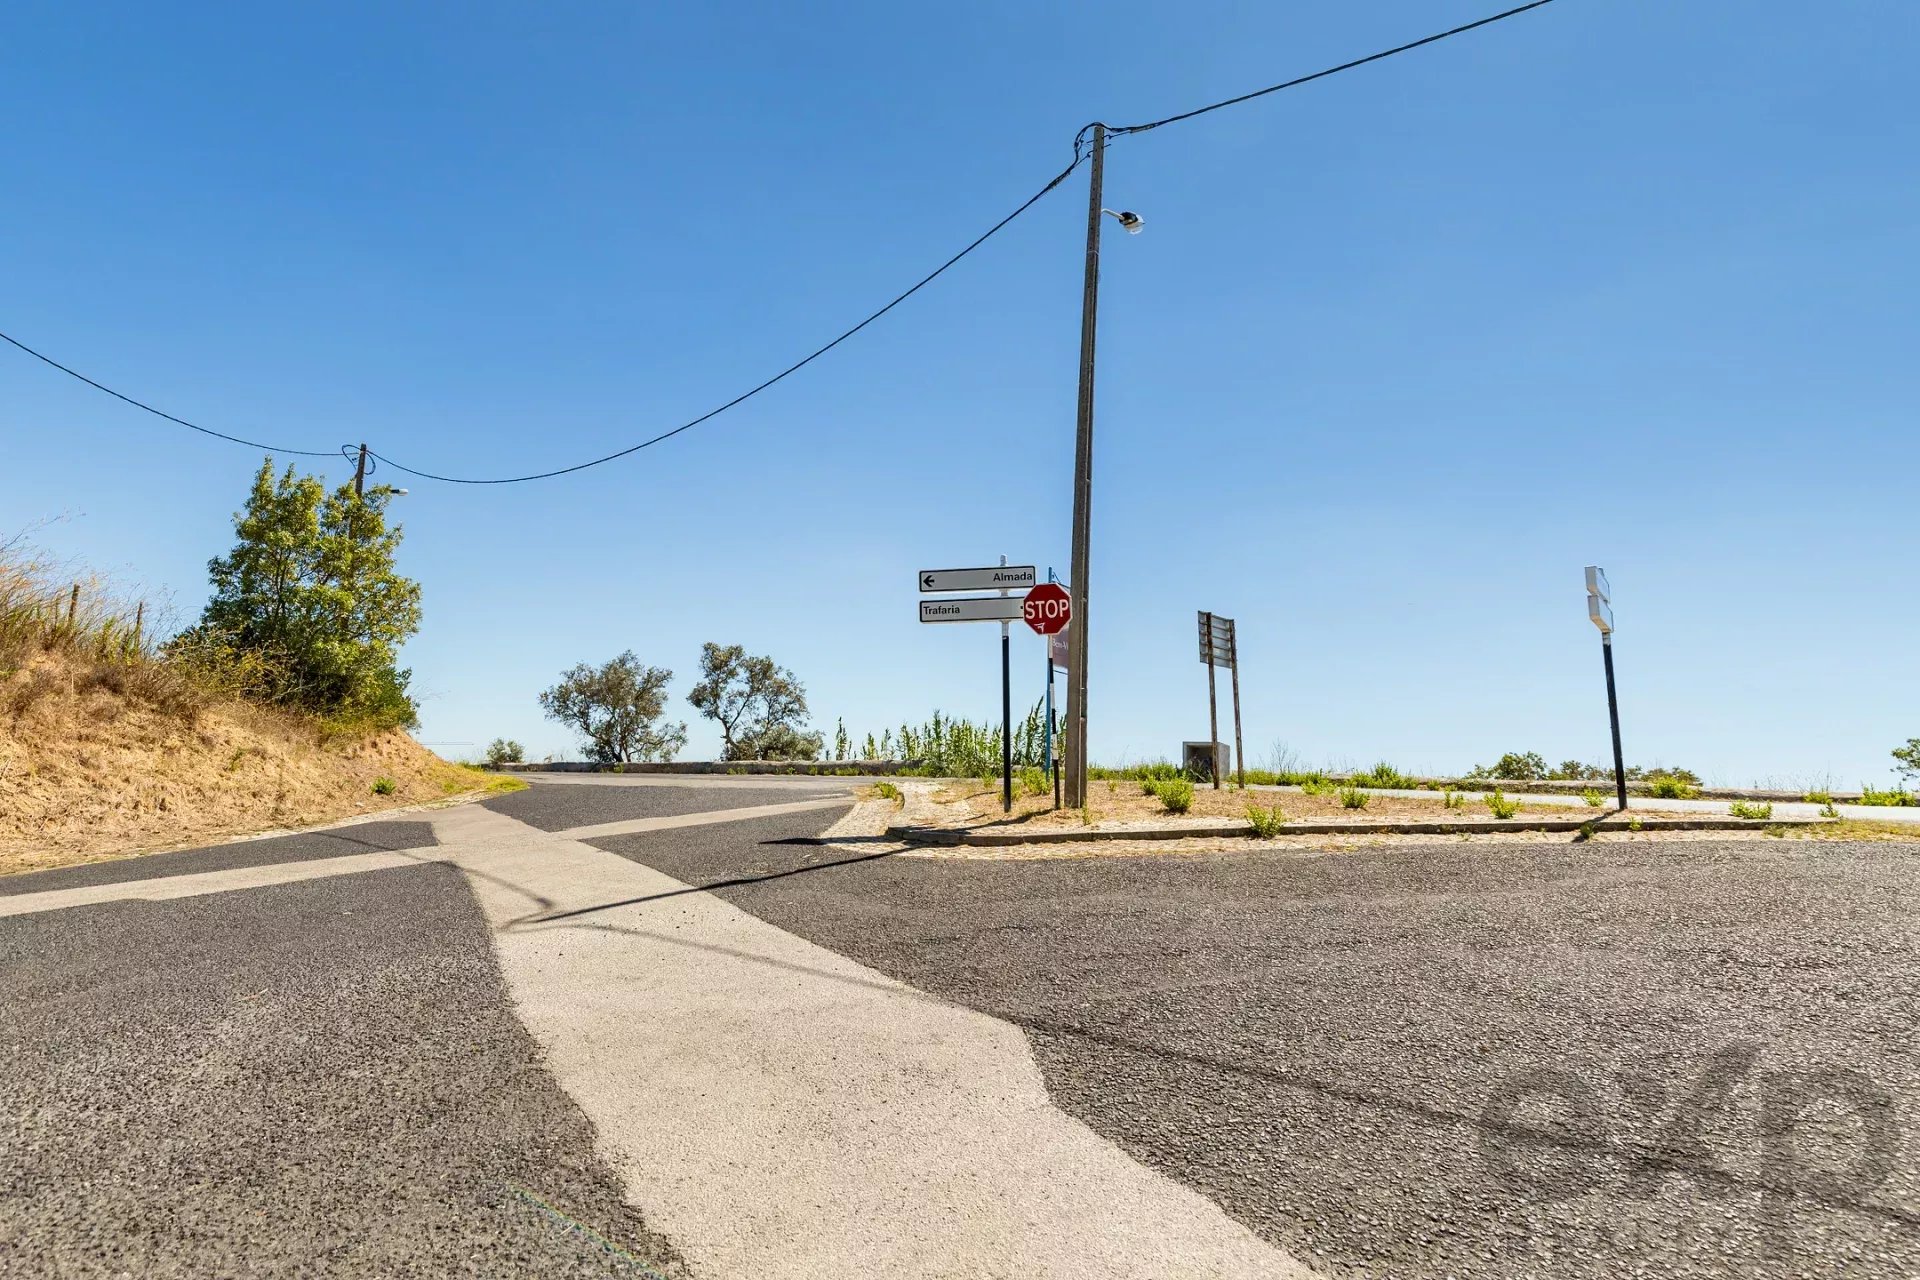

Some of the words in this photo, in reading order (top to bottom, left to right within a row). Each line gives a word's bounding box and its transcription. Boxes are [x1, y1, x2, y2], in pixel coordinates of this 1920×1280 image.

[993, 571, 1033, 582] Almada
[923, 605, 960, 615] Trafaria
[1025, 599, 1069, 620] STOP
